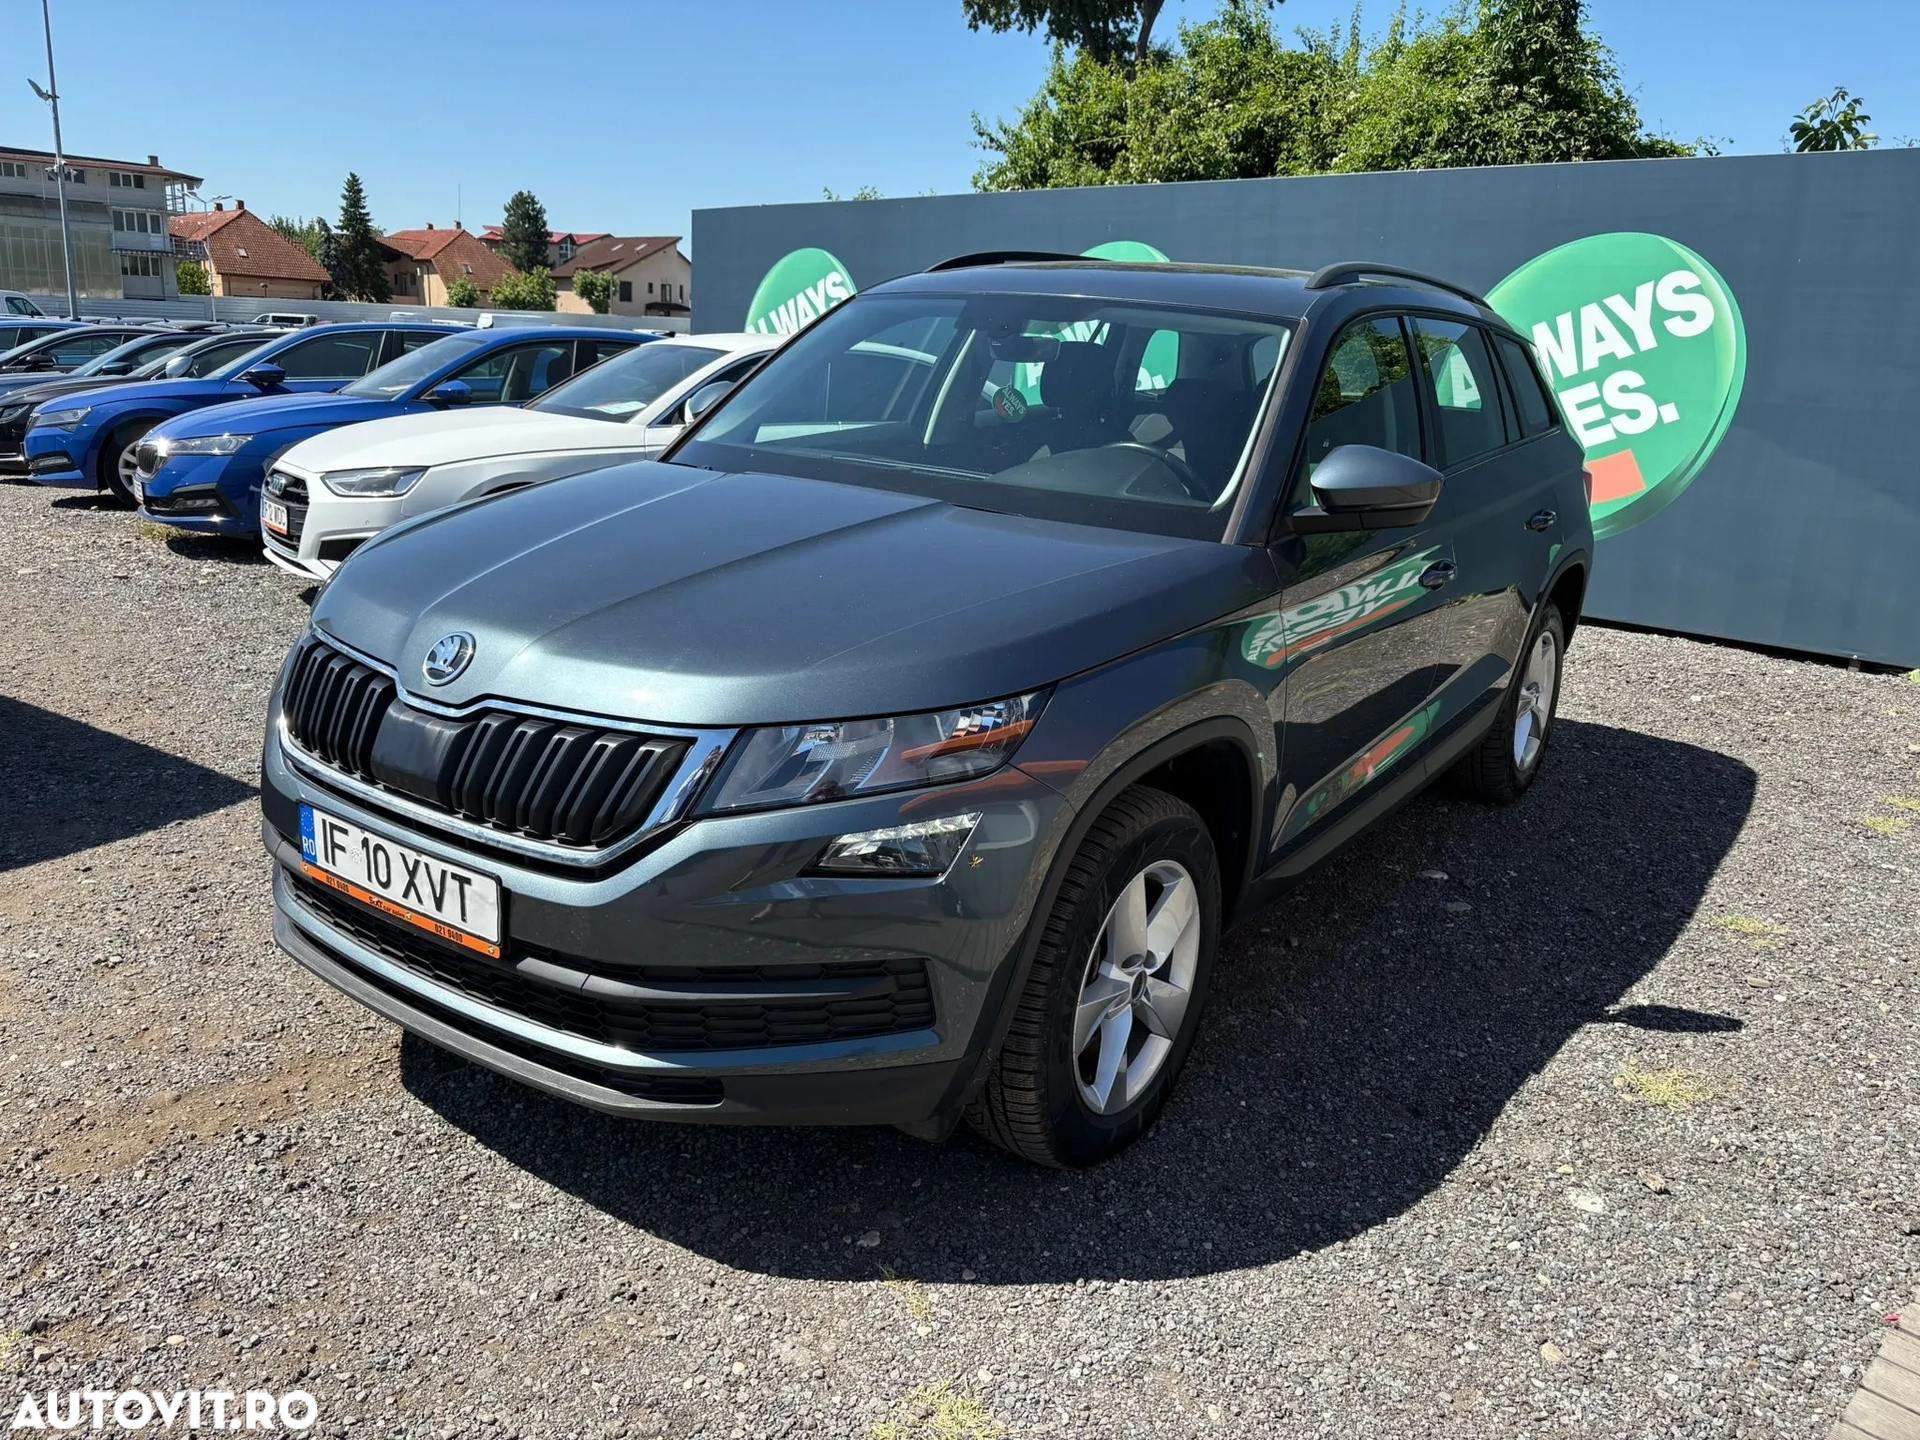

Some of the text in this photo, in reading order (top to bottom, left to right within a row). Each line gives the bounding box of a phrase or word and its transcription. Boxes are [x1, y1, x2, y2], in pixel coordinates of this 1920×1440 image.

[1002, 387, 1026, 414] ALWAYS
[1558, 370, 1680, 450] ES.
[303, 836, 316, 856] RO
[322, 818, 472, 922] IF 10 XVT
